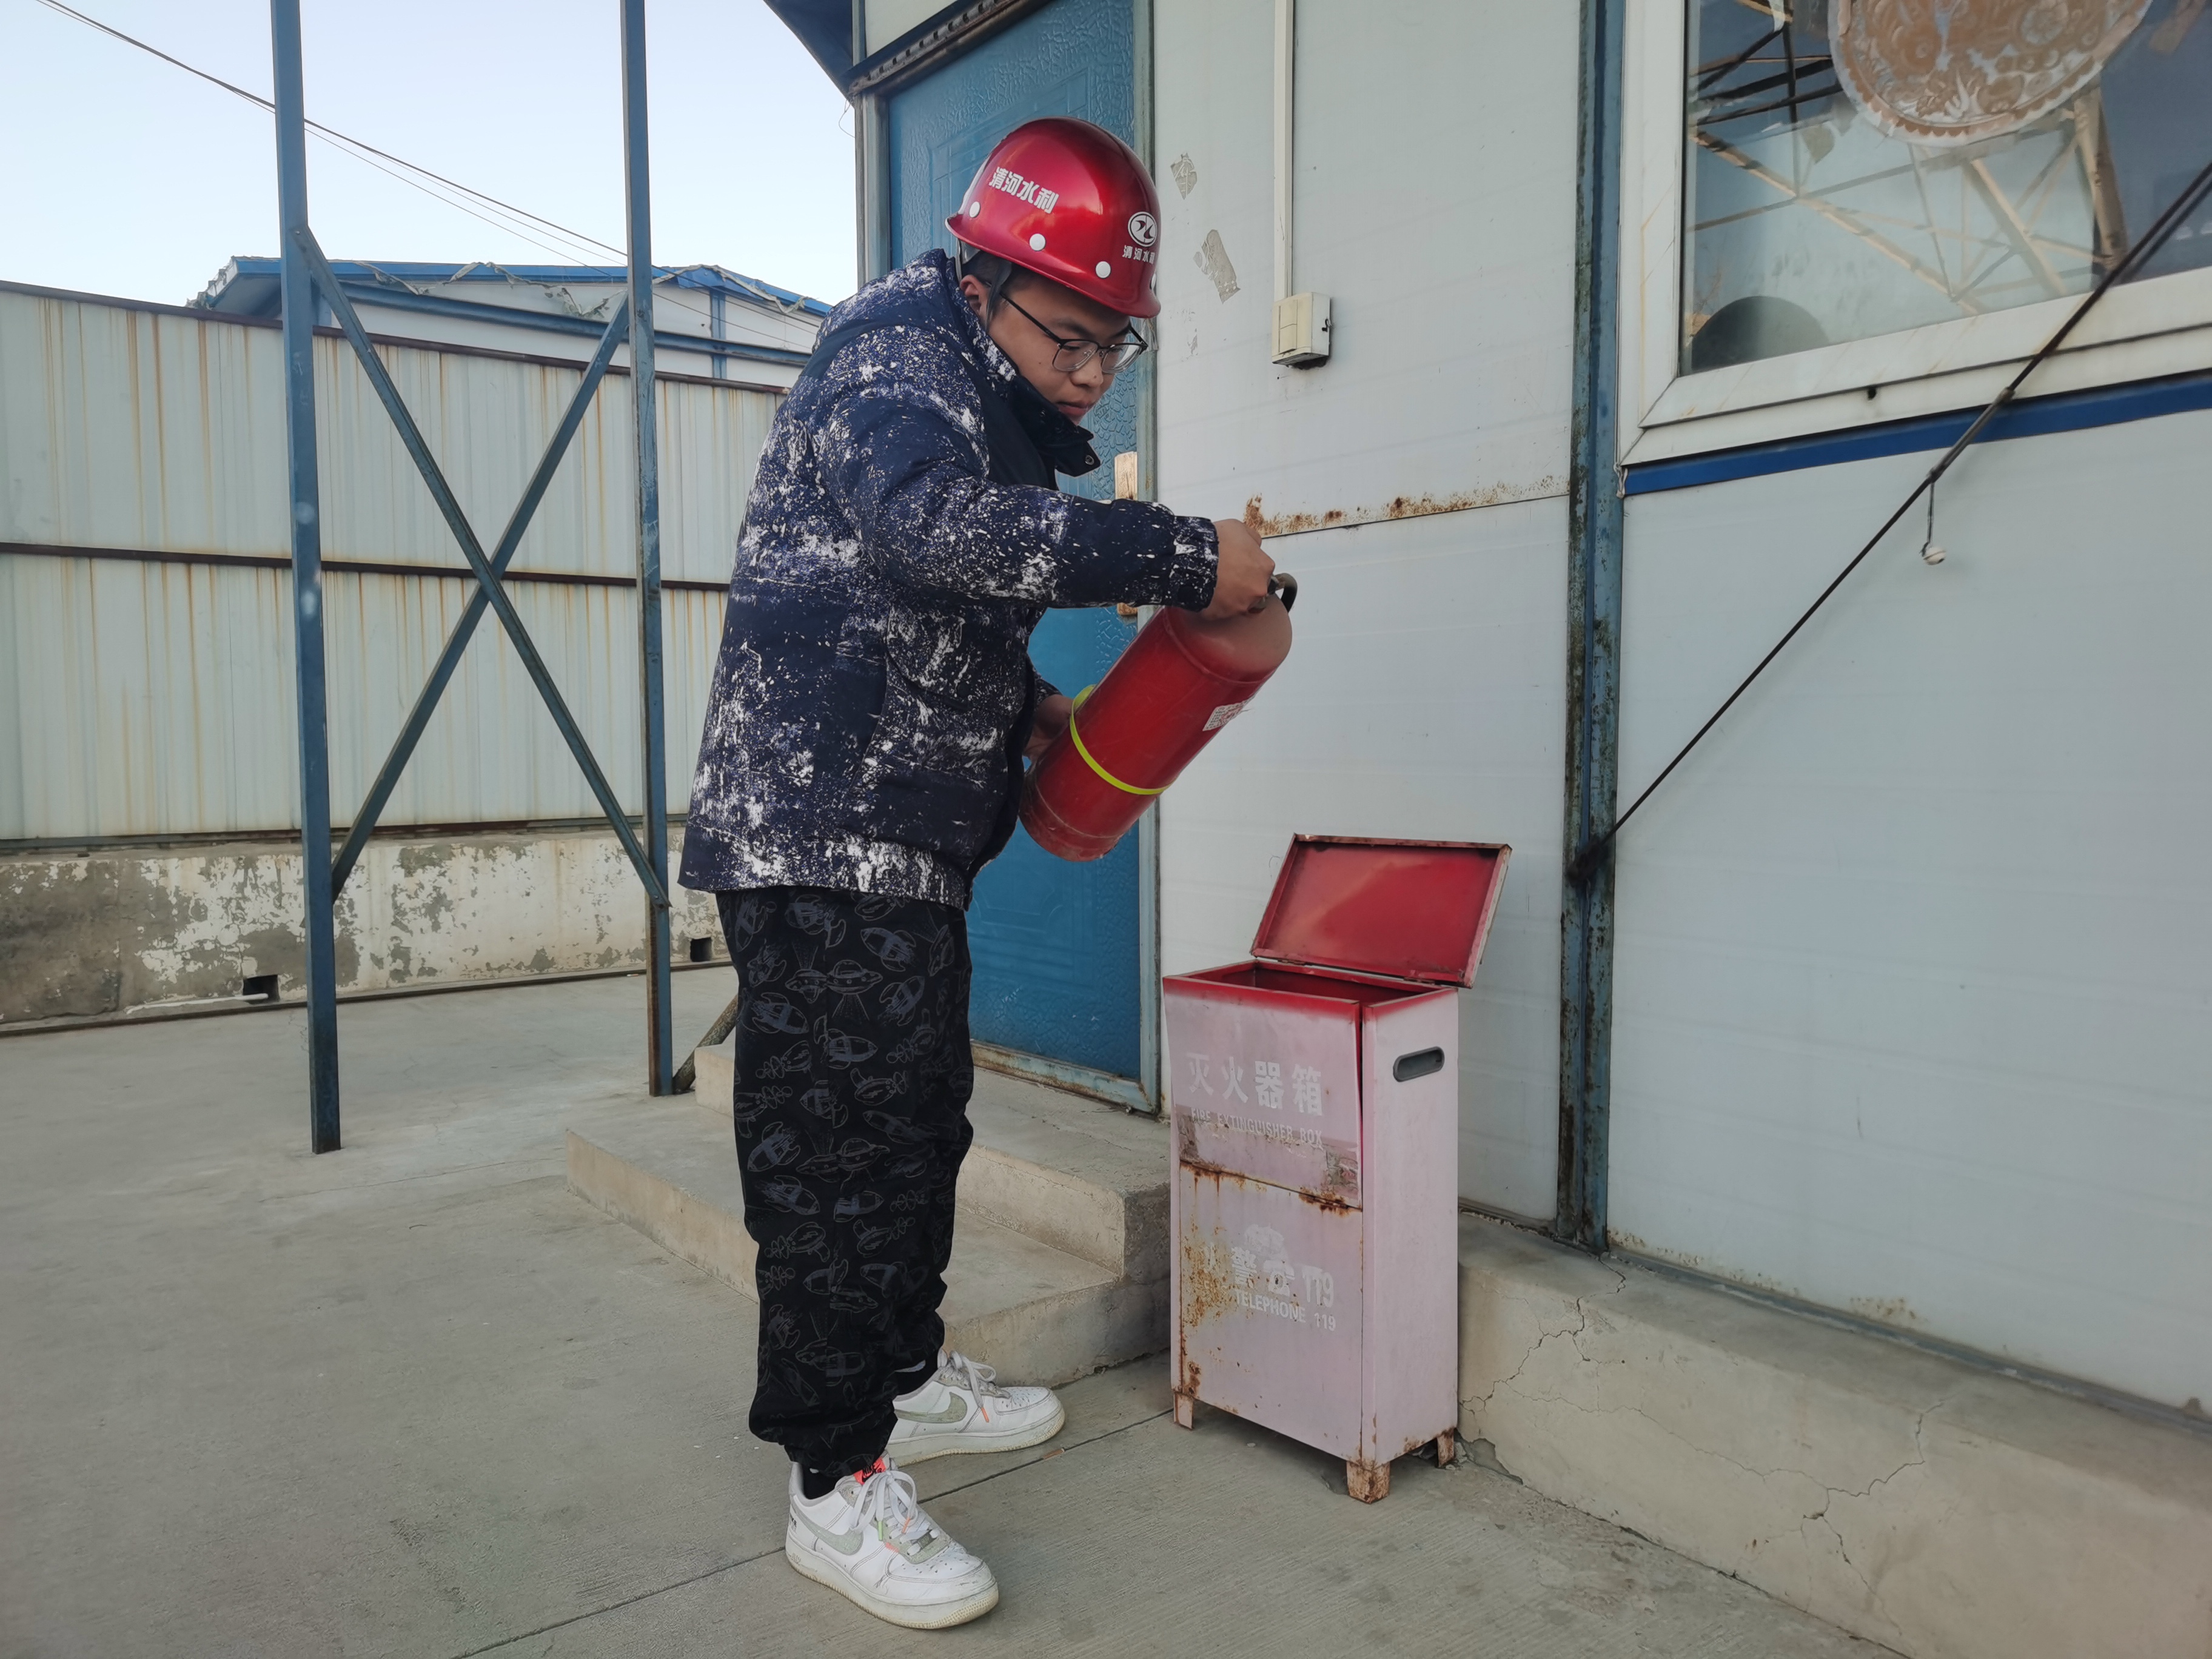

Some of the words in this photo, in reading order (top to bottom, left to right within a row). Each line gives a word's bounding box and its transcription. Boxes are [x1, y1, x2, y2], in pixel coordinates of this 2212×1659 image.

[988, 166, 1059, 213] 清河水利
[1187, 1052, 1324, 1116] 灭火器箱
[1191, 1107, 1212, 1122] FIRE
[1217, 1113, 1293, 1140] EXTINGUISHER
[1299, 1127, 1323, 1145] BOX
[1235, 1289, 1305, 1322] TELEPHONE
[1314, 1313, 1336, 1331] 119
